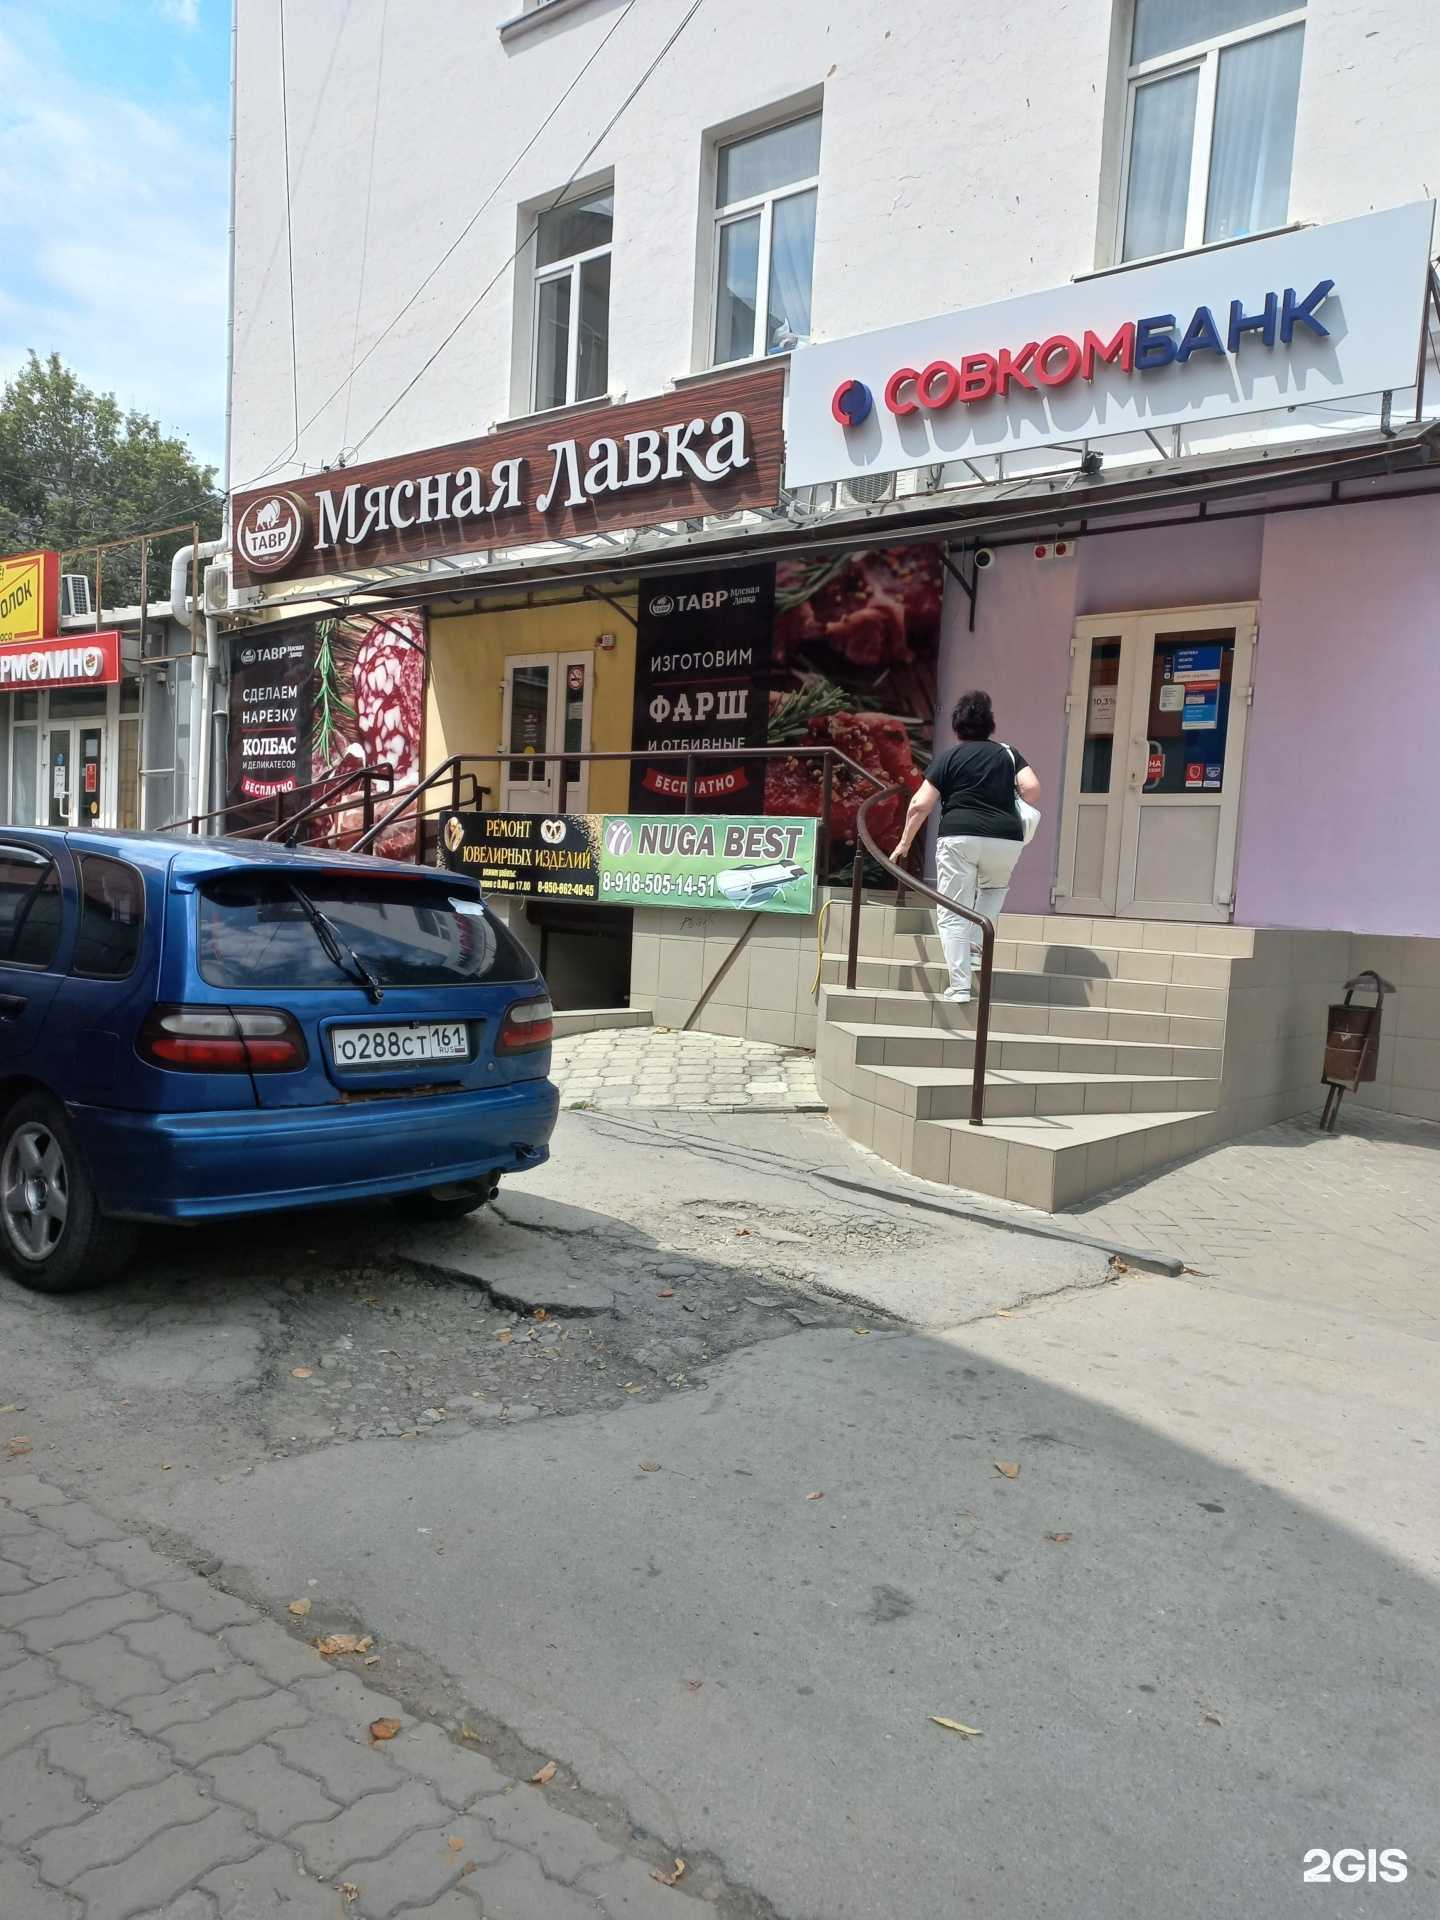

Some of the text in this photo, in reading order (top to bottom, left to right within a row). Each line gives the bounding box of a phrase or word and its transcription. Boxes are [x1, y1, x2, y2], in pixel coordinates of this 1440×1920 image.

[884, 279, 1335, 416] СОВКОМБАНК
[314, 411, 750, 550] Мясная Лавка
[251, 532, 287, 551] ТАВР
[676, 590, 728, 612] ТАВР
[257, 646, 287, 662] ТАВР
[651, 648, 752, 672] ИЗГОТОВИМ
[242, 685, 298, 704] СДЕЛАЕМ
[242, 708, 298, 724] НАРЕЗКУ
[649, 690, 749, 723] ФАРШ
[242, 736, 297, 756] КОЛБАС
[648, 737, 746, 752] И ОТБИВНЫЕ
[248, 760, 296, 770] ДЕЛИКАТЕСОВ
[244, 780, 294, 797] БЕСПЛАТНО
[486, 818, 533, 839] РЕМОНТ
[638, 824, 805, 860] NUGA BEST
[463, 844, 591, 870] ЮВЕЛИРНЫХ ИЗДЕЛИЙ
[602, 871, 715, 897] 8-918-505-14-51
[432, 1027, 462, 1047] 161
